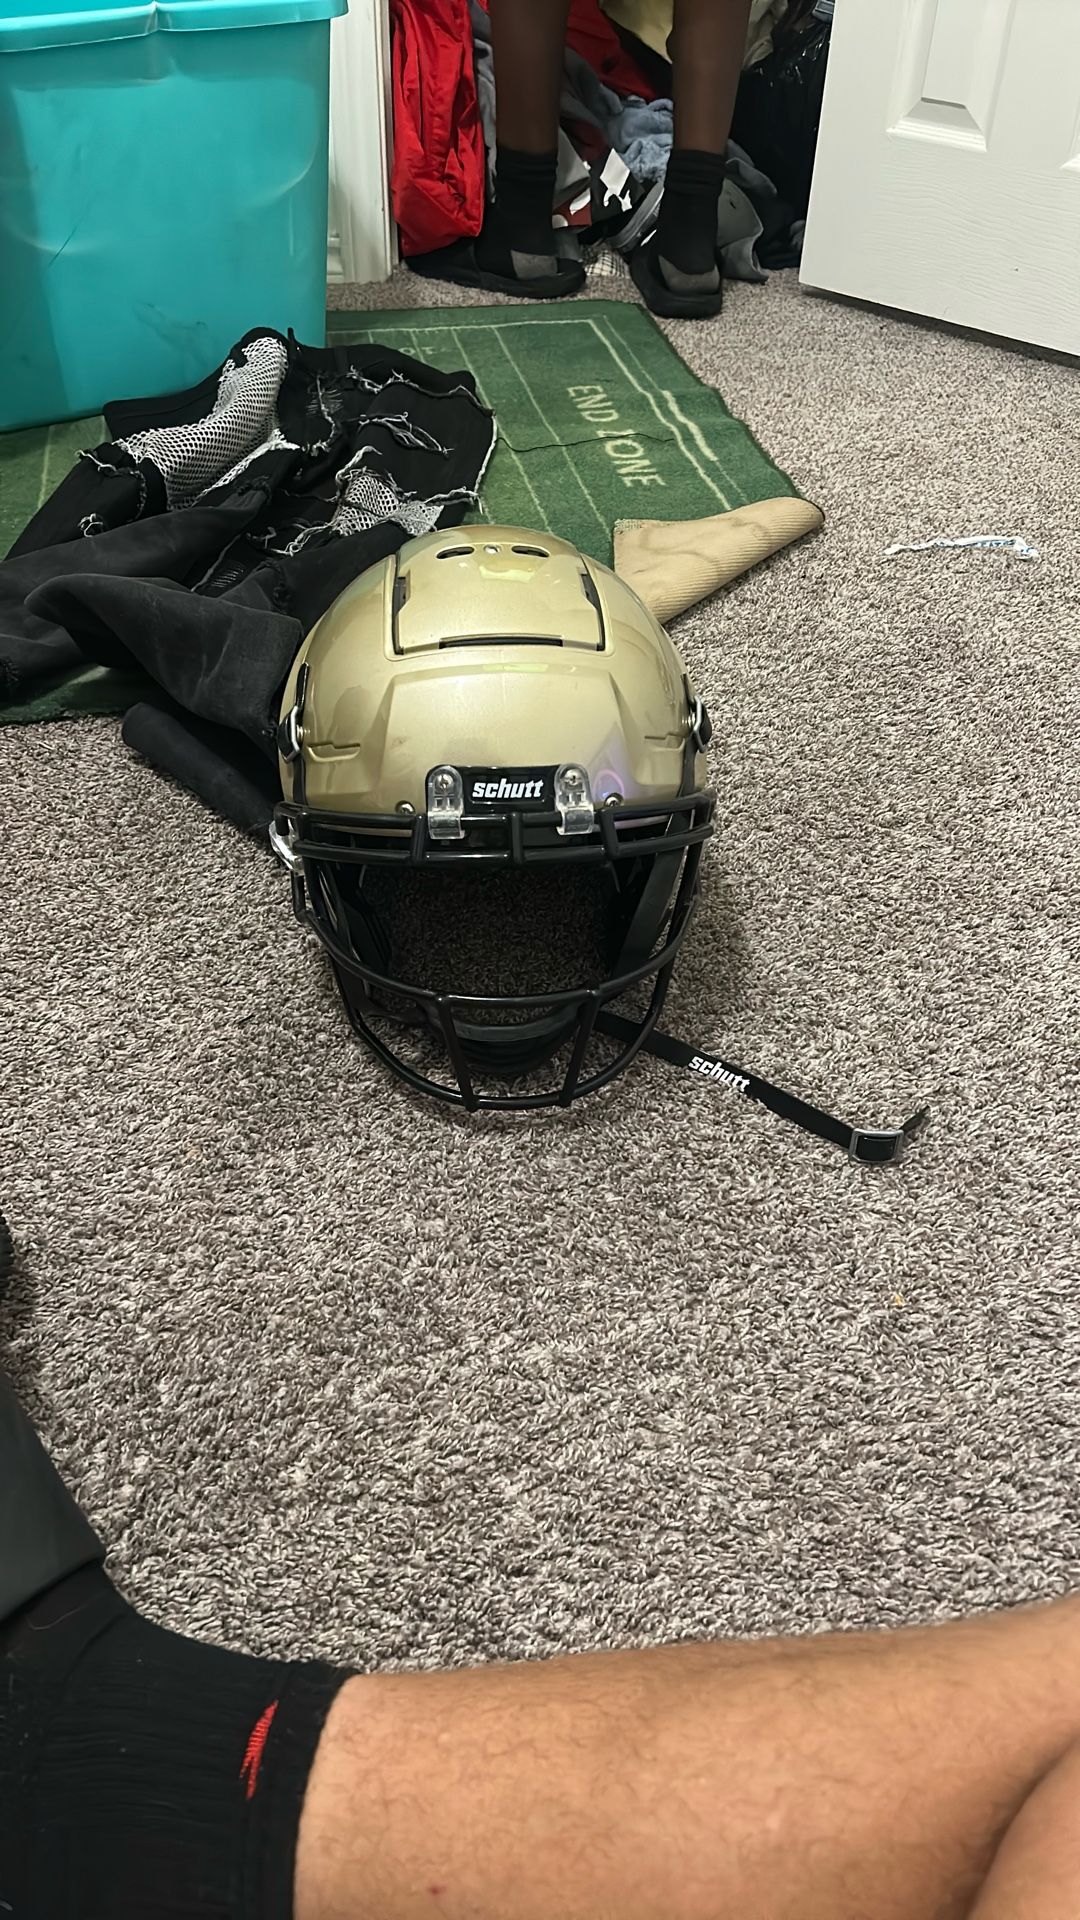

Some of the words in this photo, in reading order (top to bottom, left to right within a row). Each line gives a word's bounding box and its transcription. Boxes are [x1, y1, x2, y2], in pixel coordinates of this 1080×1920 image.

[566, 385, 619, 422] END
[472, 778, 544, 798] schutt
[688, 1055, 750, 1092] schutt
